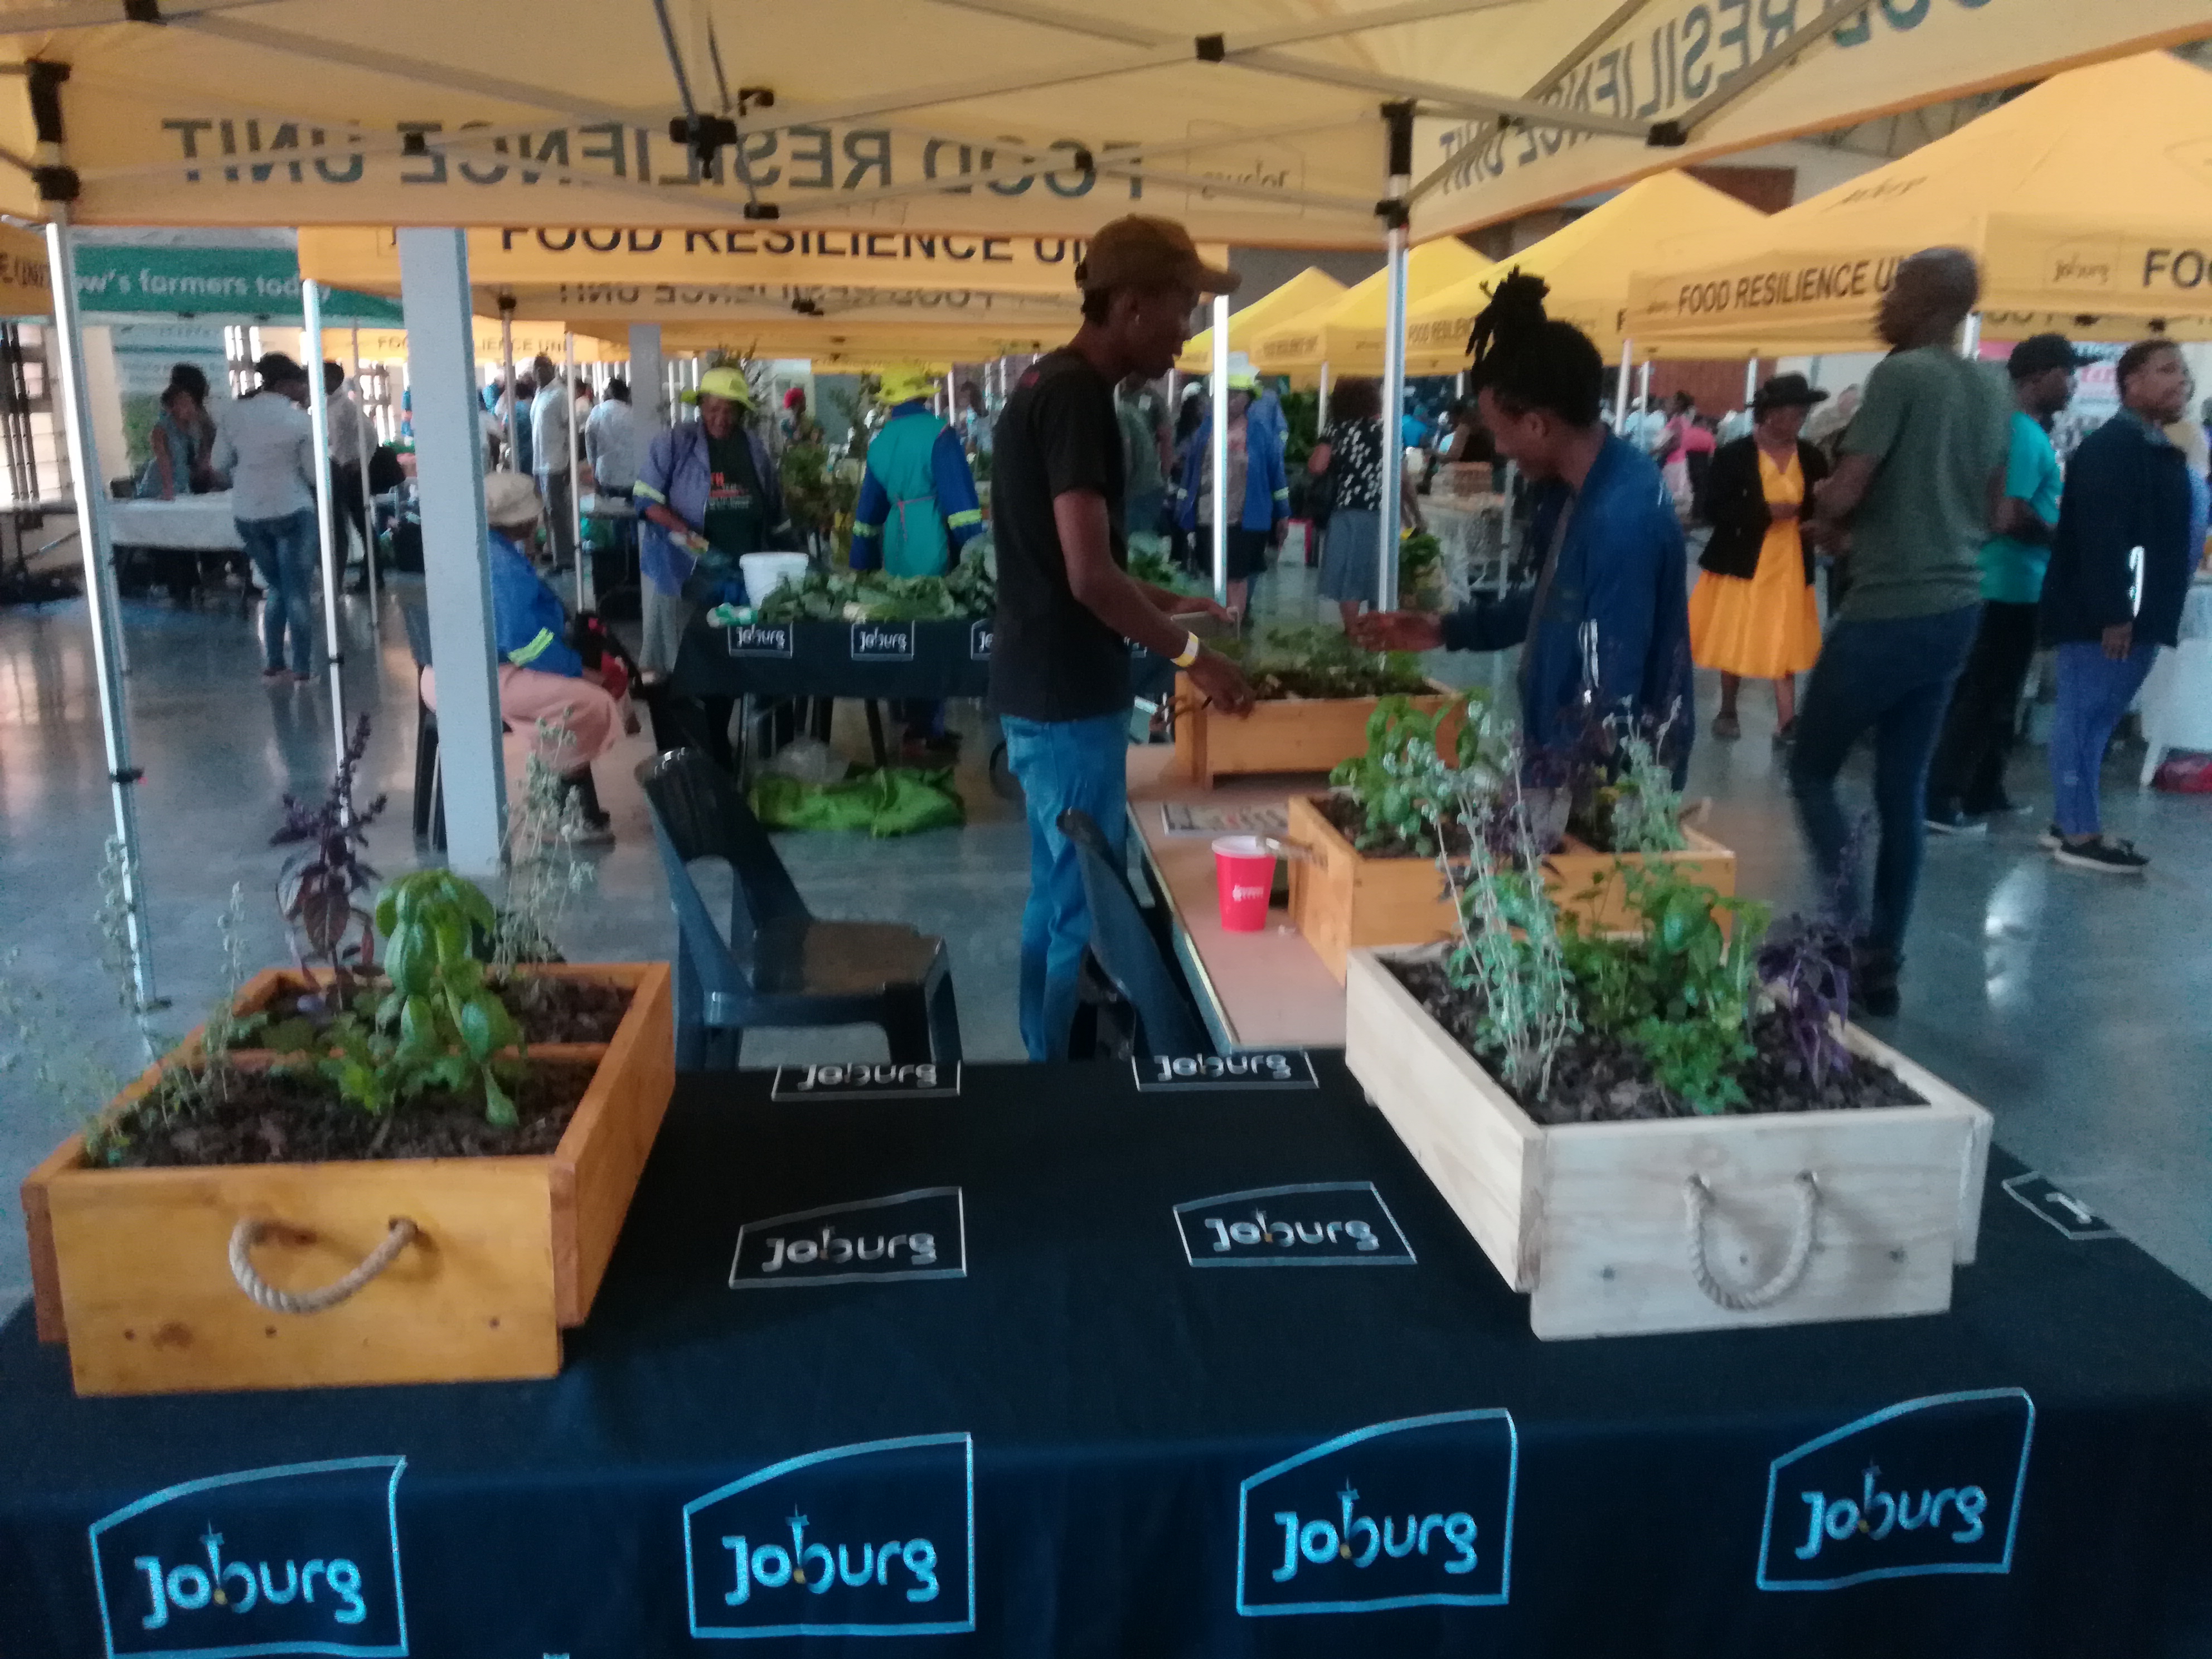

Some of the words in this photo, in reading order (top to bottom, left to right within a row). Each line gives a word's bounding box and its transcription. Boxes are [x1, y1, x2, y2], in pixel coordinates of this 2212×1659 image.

[138, 268, 248, 297] farmers
[1679, 281, 1729, 315] FOOD
[1734, 259, 1870, 309] RESILIENCE
[2142, 247, 2212, 289] FO
[797, 1062, 937, 1092] Joburg
[1153, 1053, 1291, 1082] Joburg
[761, 1226, 937, 1272] Joburg
[1205, 1210, 1380, 1252] Joburg
[1272, 1476, 1478, 1582] Joburg
[1794, 1456, 1987, 1560] Joburg
[134, 1521, 368, 1630] Joburg
[722, 1503, 940, 1606] Joburg
